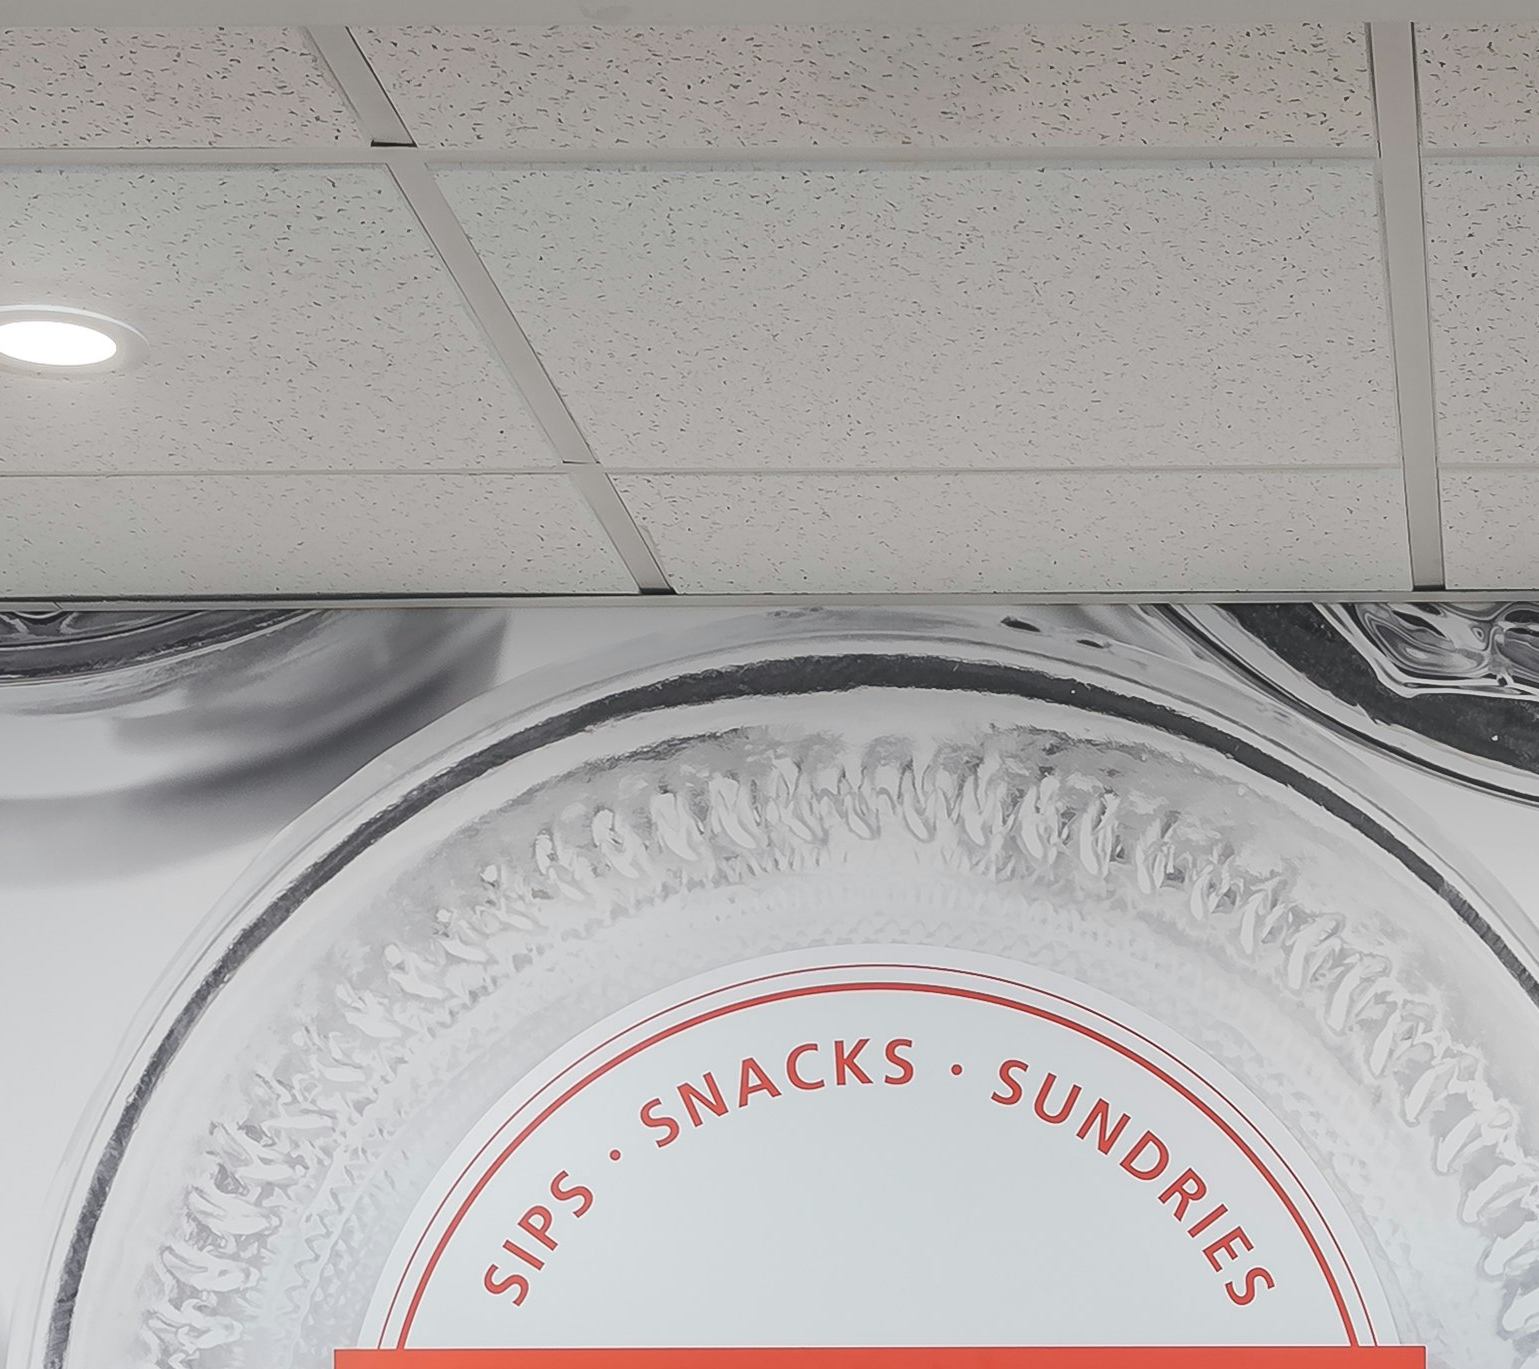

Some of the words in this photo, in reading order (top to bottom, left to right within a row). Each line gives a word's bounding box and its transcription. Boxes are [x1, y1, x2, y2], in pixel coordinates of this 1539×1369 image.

[482, 1170, 594, 1307] SIPS
[639, 1038, 915, 1148] SNACKS
[991, 1058, 1276, 1307] SUNDRIES
